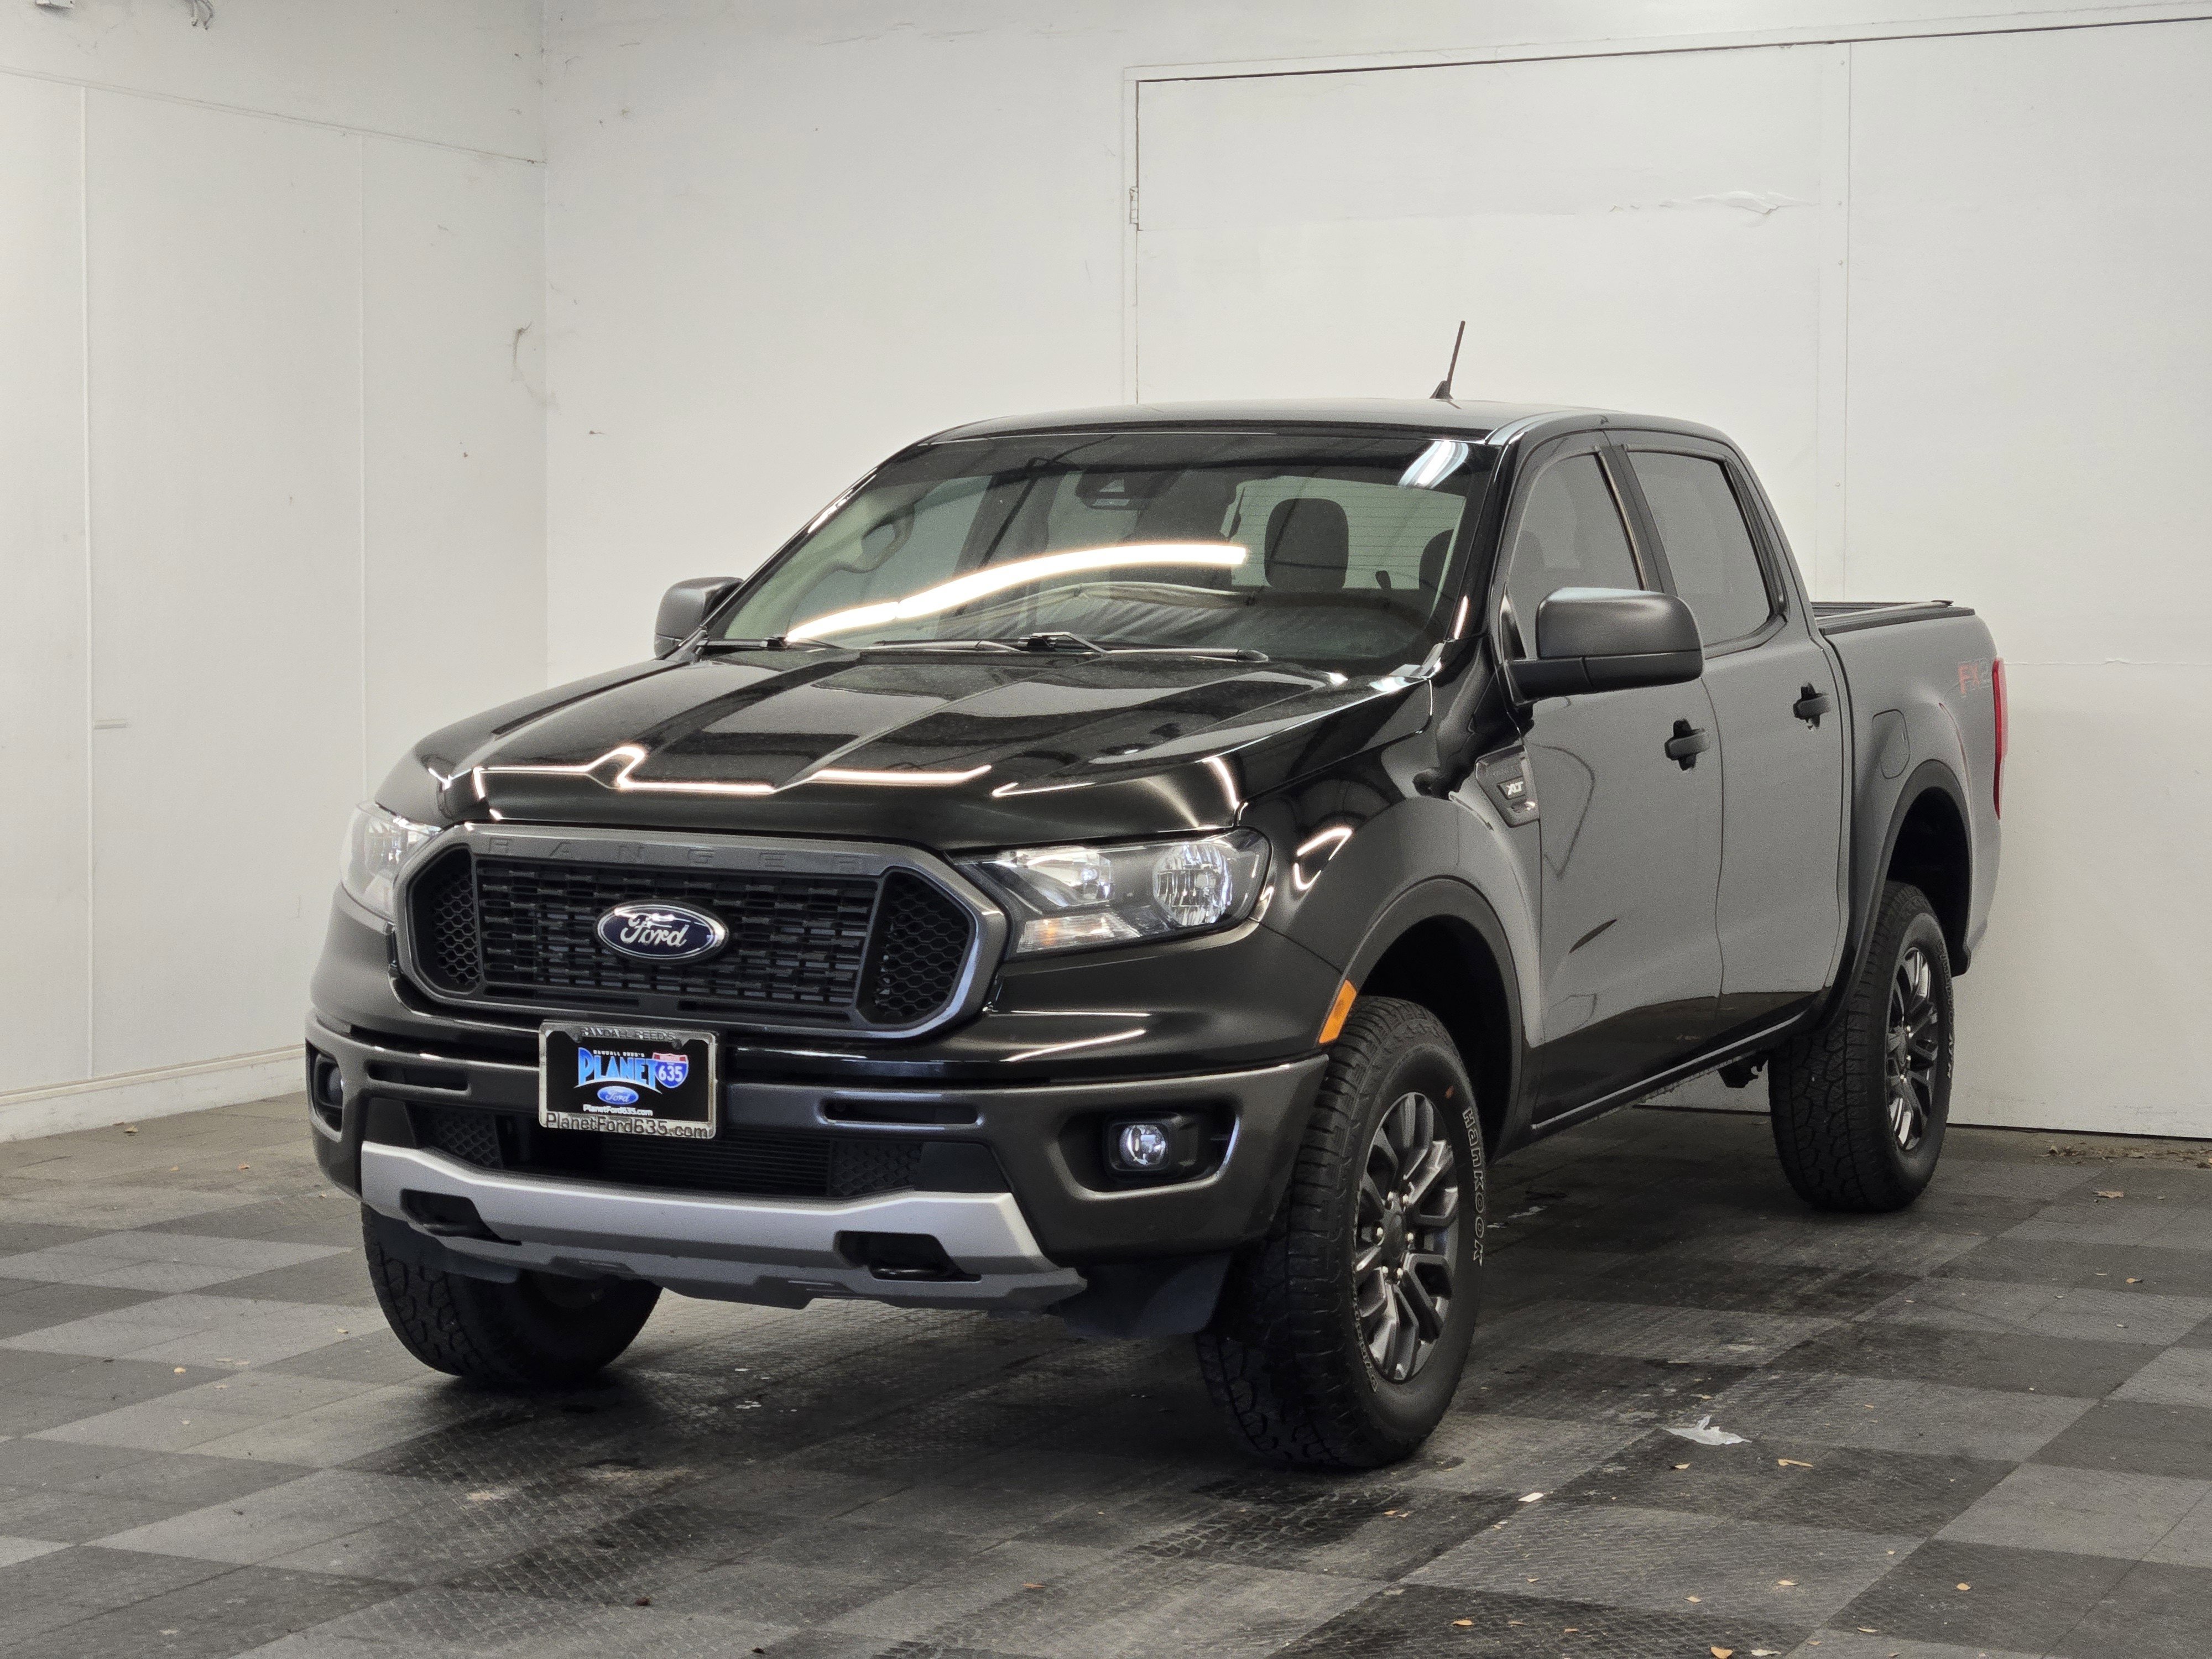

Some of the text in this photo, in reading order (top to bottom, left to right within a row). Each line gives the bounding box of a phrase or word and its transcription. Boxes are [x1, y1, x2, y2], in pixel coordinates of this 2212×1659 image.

[1506, 781, 1524, 795] XLT
[488, 837, 863, 872] RANGER
[620, 913, 689, 947] Ford
[581, 1027, 633, 1039] RANDALL
[578, 1047, 683, 1089] PLANET 635
[605, 1089, 630, 1102] Ford
[546, 1112, 708, 1138] PlanetFord635.com
